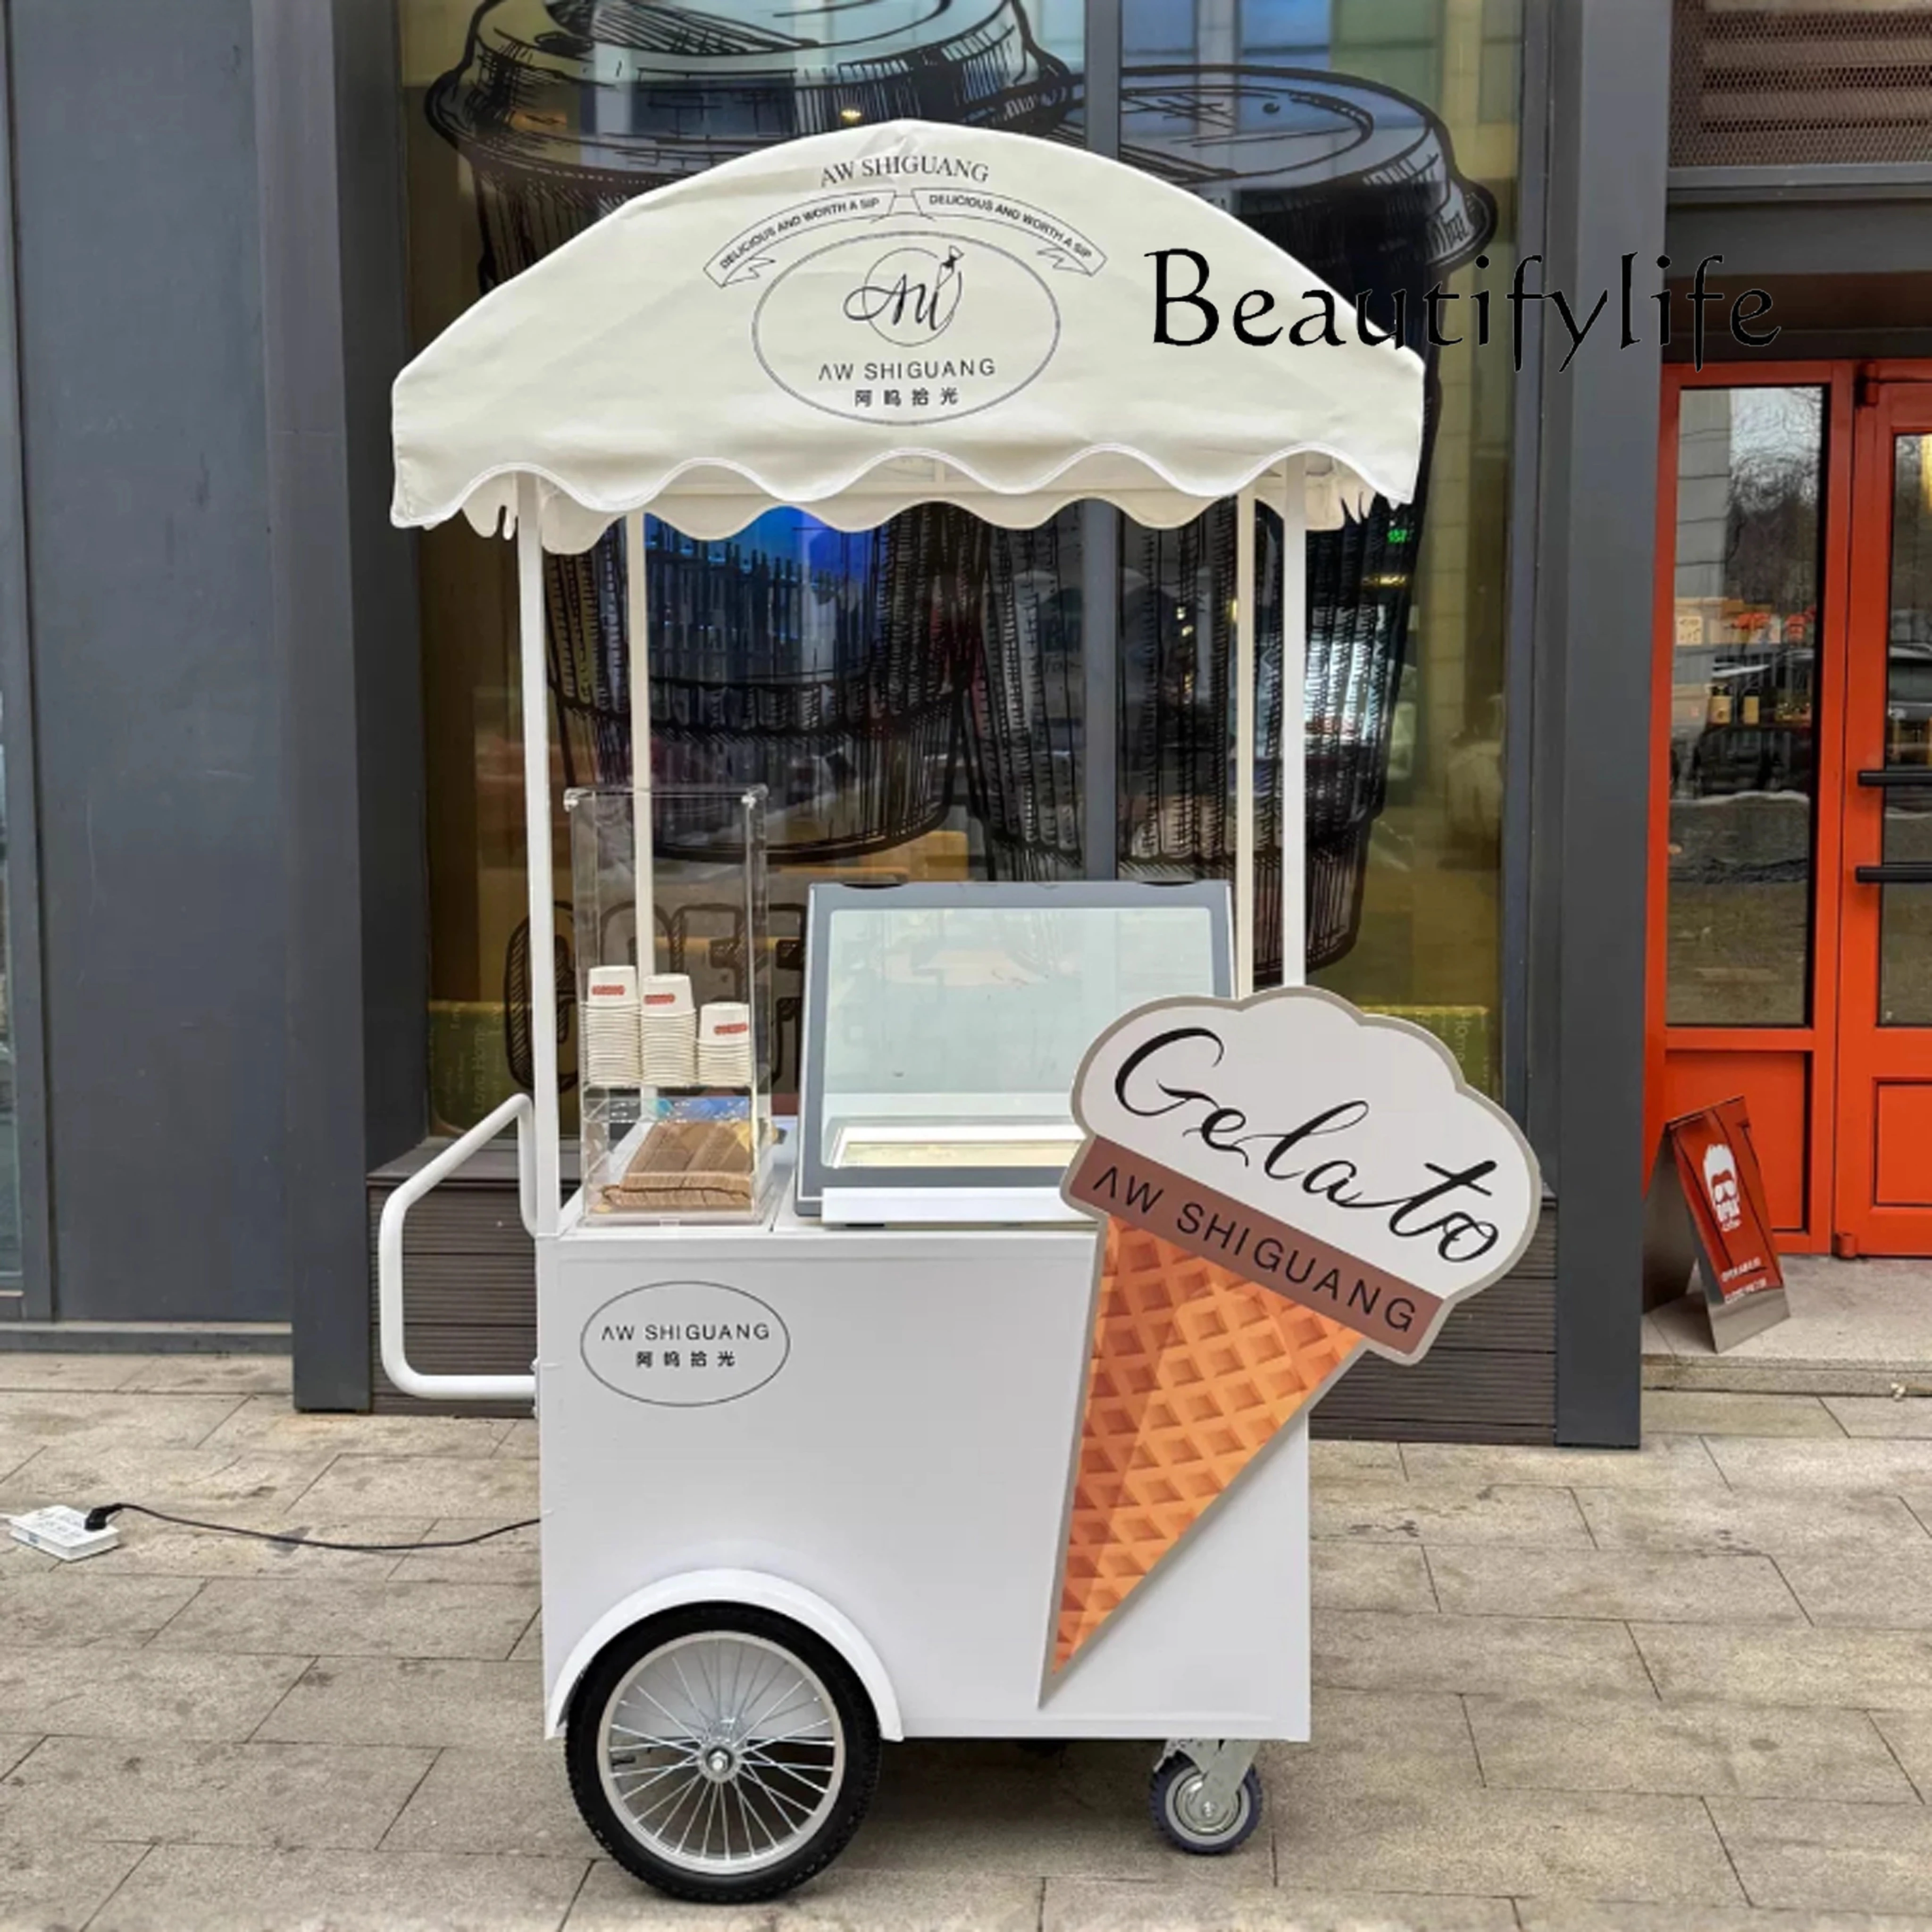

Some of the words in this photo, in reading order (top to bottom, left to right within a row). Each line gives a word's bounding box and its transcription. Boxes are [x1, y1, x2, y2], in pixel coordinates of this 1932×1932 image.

[820, 160, 854, 188] AW
[861, 155, 989, 183] SHIGUANG
[719, 226, 776, 270] DELICIOUS
[777, 215, 802, 233] AND
[802, 203, 847, 222] WORTH
[850, 201, 859, 211] A
[860, 197, 880, 209] SIP
[929, 194, 993, 211] DELICIOUS
[995, 204, 1021, 220] AND
[1021, 212, 1064, 243] WORTH
[1063, 236, 1074, 249] A
[1072, 242, 1093, 259] SIP
[864, 358, 995, 381] SHIGUANG
[1114, 1027, 1499, 1263] Gelato
[1176, 1203, 1415, 1332] SHIGUANG
[644, 1323, 769, 1340] SHIGUANG
